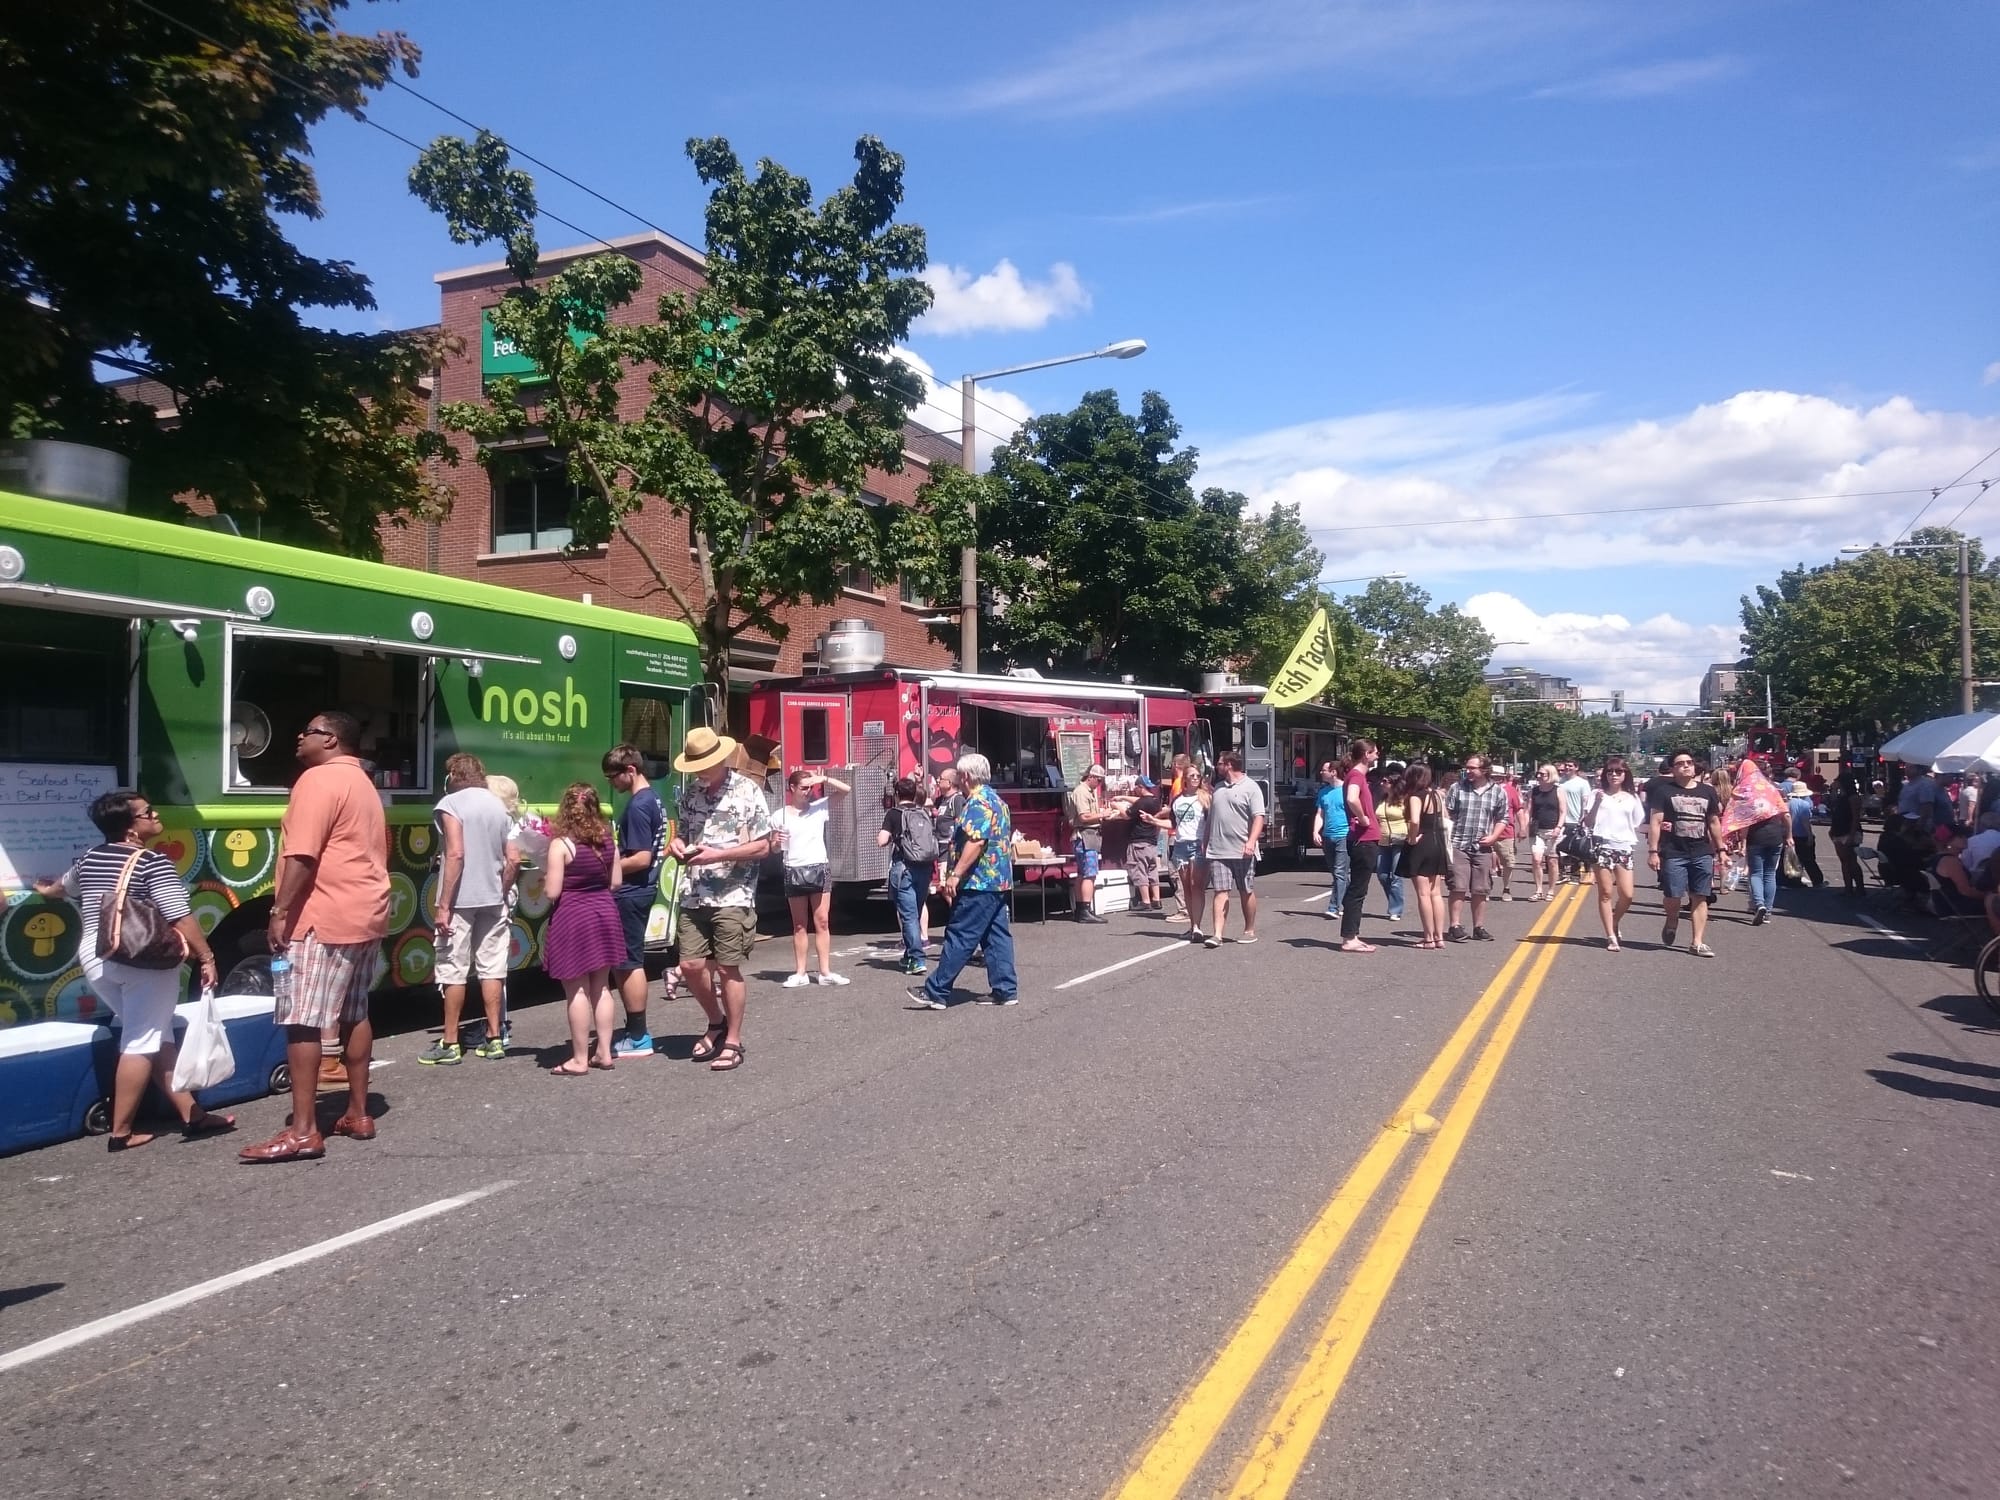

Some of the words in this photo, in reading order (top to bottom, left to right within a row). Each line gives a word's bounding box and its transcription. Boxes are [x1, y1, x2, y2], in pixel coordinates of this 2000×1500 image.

[1275, 669, 1312, 698] Fish
[483, 676, 588, 728] nosh
[503, 730, 514, 740] it's
[515, 731, 525, 740] all
[526, 731, 544, 741] about
[545, 732, 555, 742] the
[557, 733, 571, 743] food
